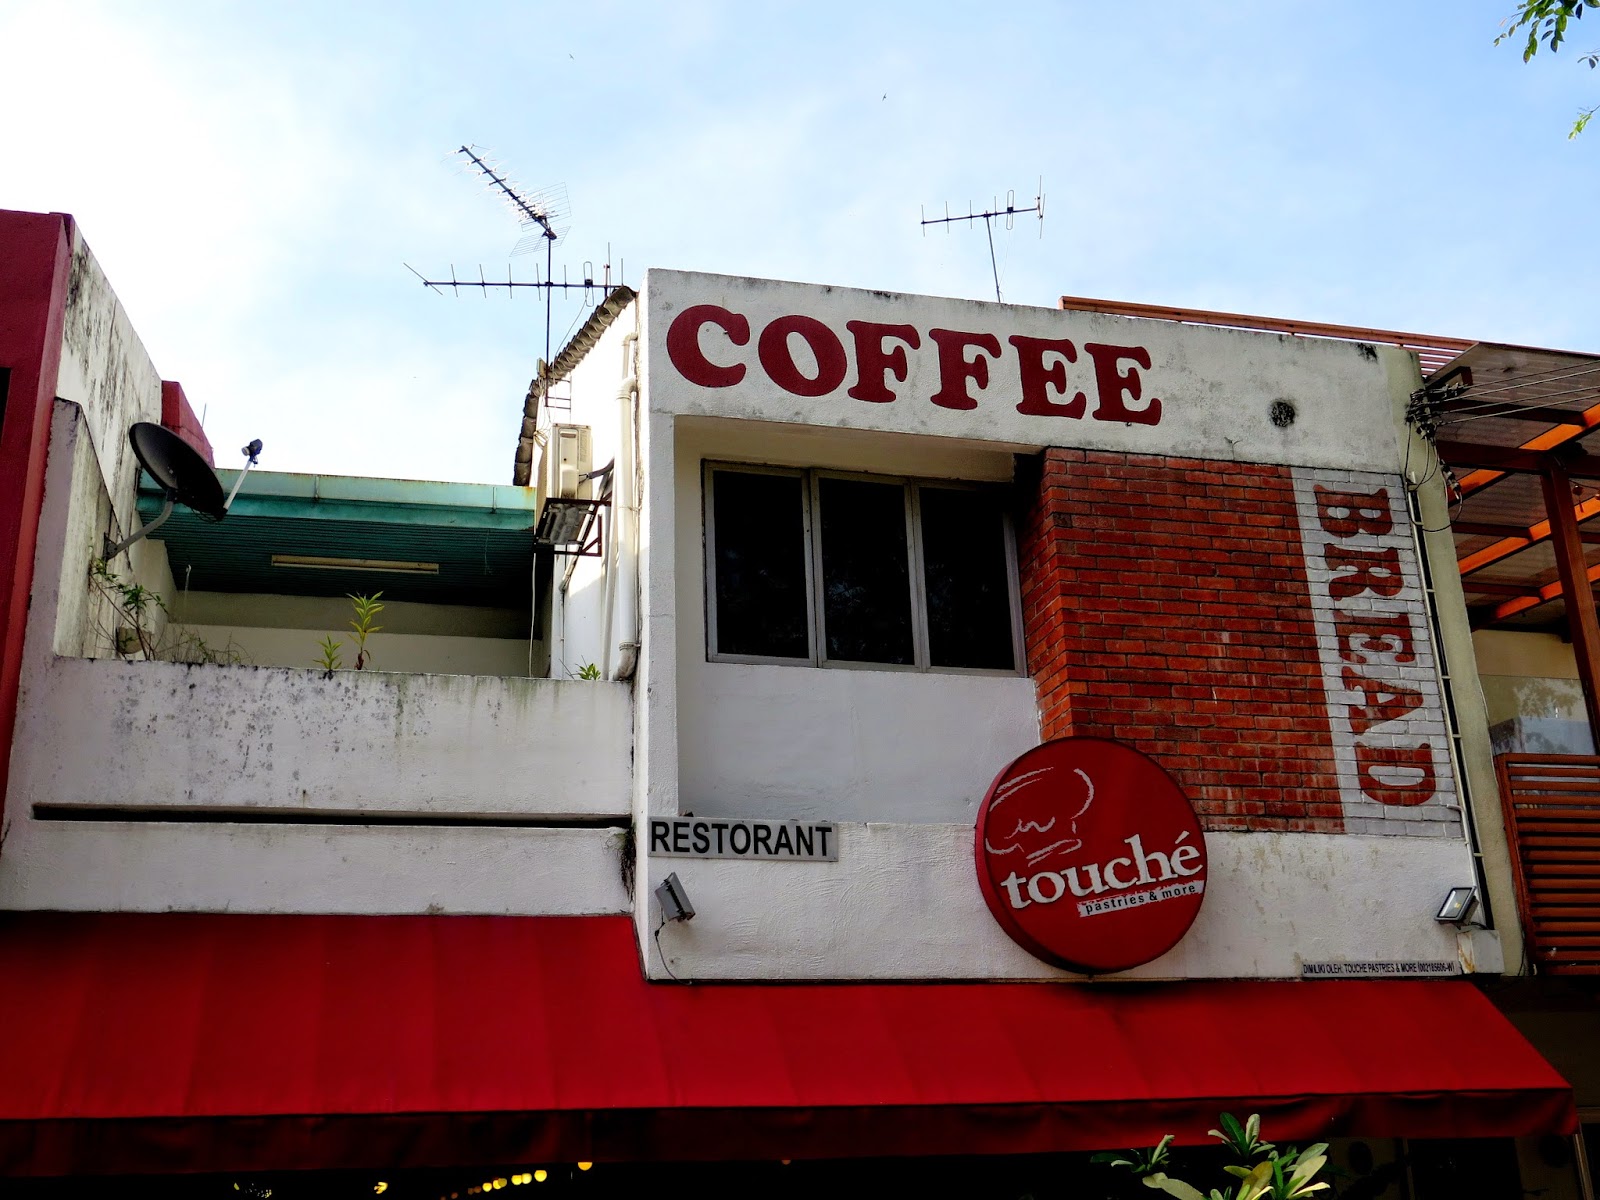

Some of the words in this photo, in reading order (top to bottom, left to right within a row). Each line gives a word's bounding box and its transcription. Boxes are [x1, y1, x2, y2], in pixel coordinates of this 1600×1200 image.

[666, 304, 1162, 426] COFFEE
[1313, 484, 1436, 806] BREAD
[651, 820, 832, 857] RESTORANT
[1001, 830, 1203, 909] touché
[1085, 894, 1145, 915] pastries
[1149, 891, 1158, 901] &
[1161, 884, 1196, 899] more
[1344, 963, 1367, 973] TOUCHE
[1368, 963, 1395, 973] PASTRIES
[1401, 963, 1417, 972] MORE
